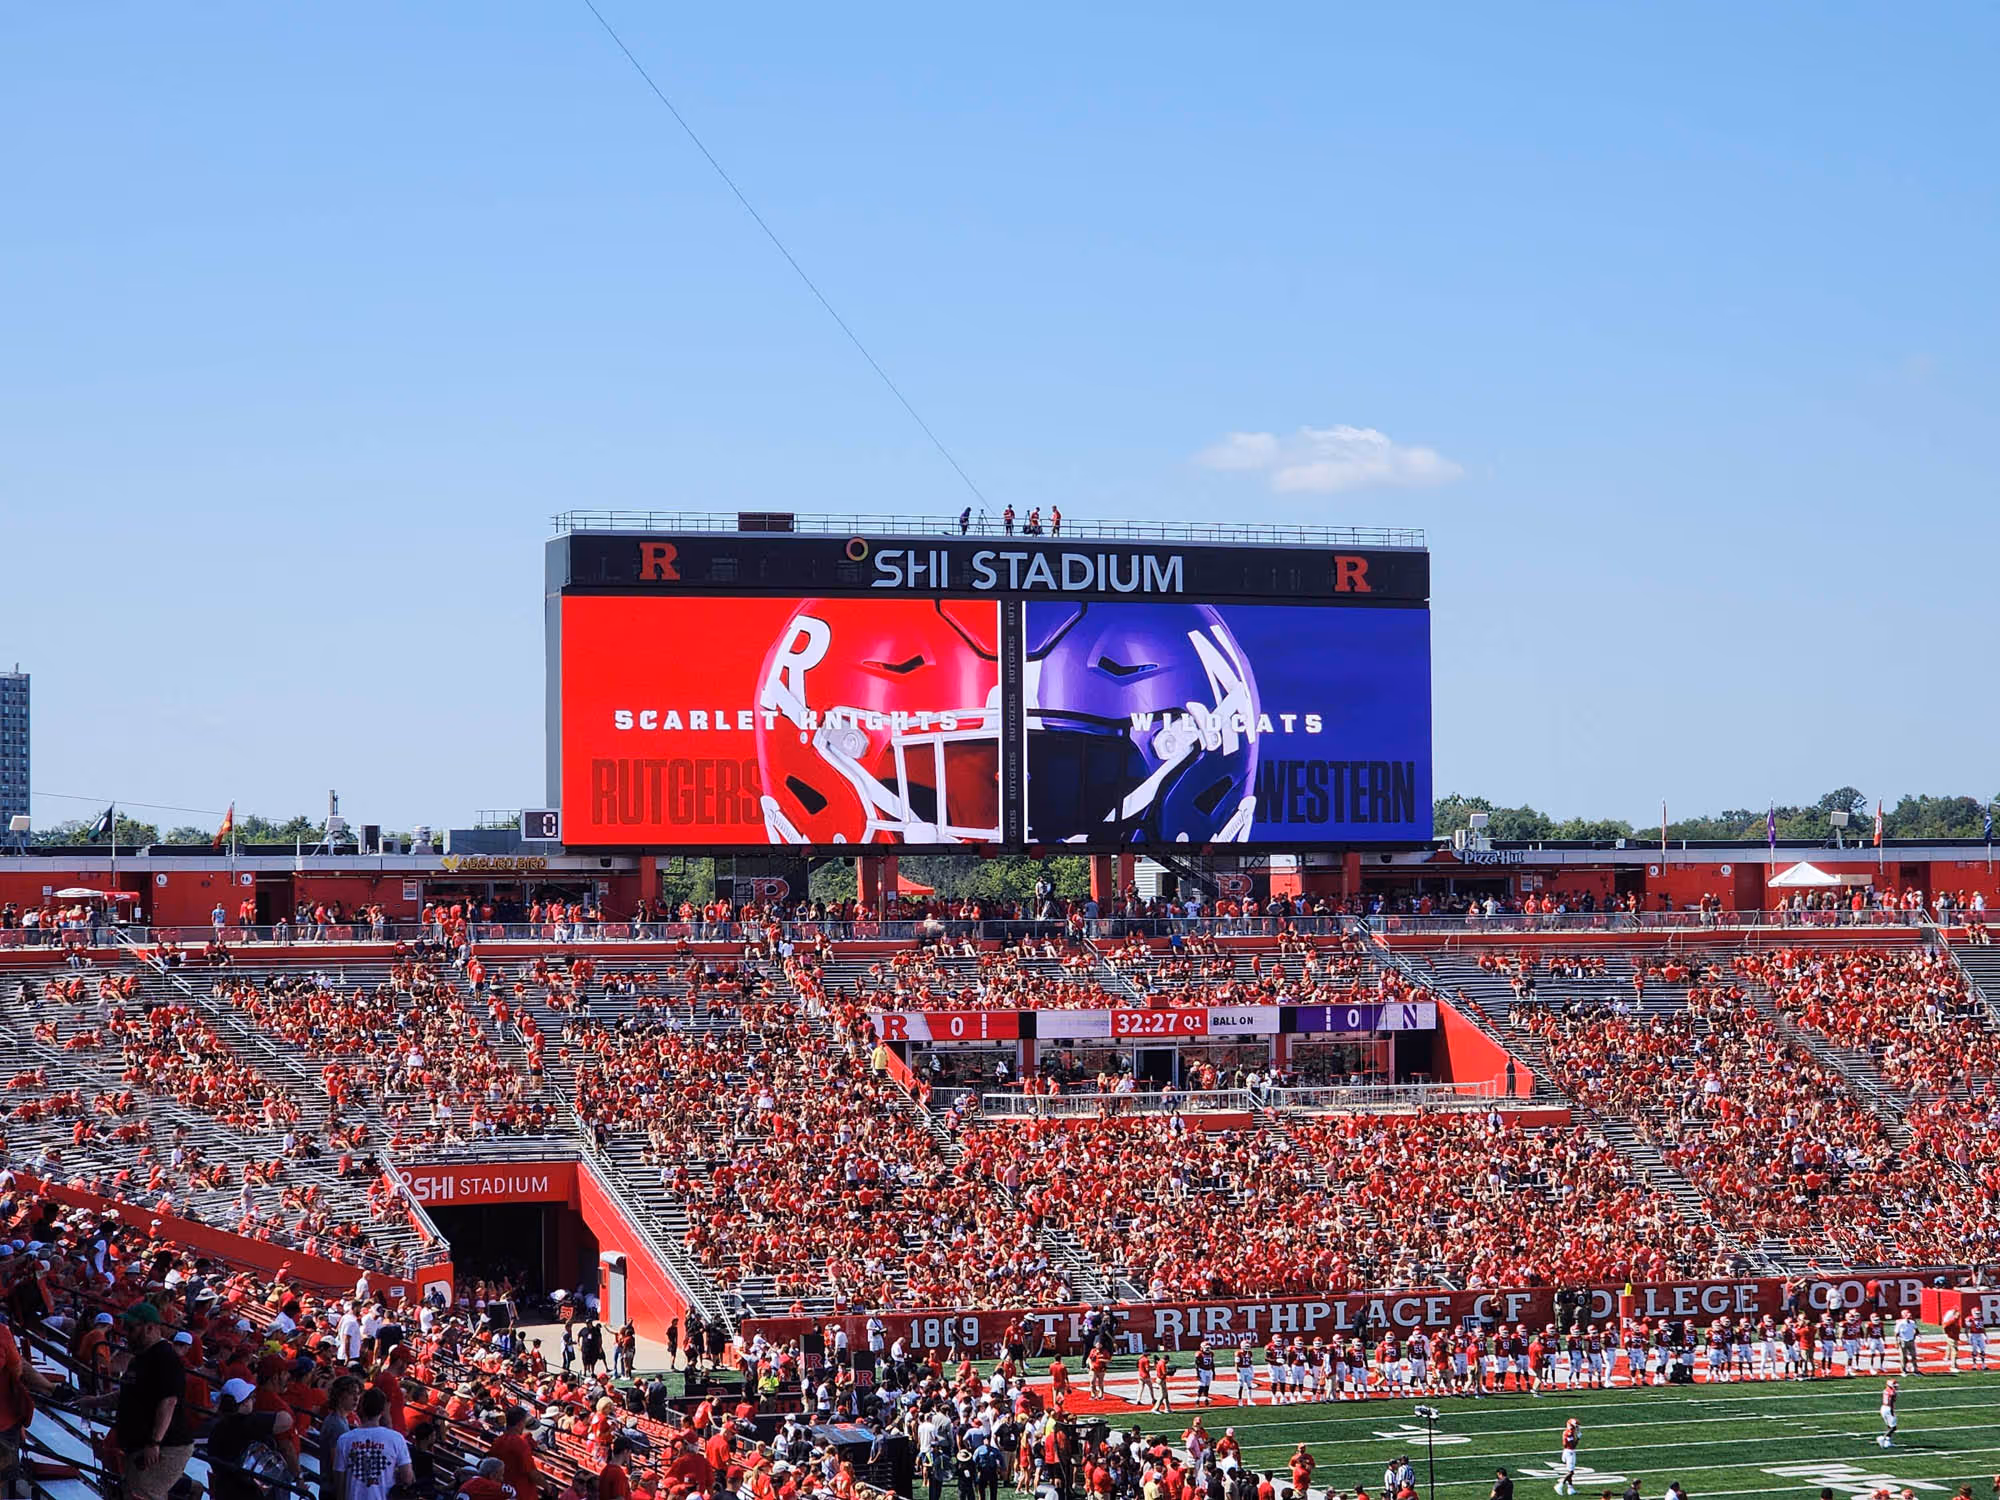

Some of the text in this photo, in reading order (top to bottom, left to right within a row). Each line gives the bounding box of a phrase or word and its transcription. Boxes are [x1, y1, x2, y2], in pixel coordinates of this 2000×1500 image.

[639, 542, 681, 581] R
[871, 549, 1184, 593] SHI STADIUM
[1334, 555, 1372, 593] R
[614, 709, 959, 731] SCARLET KNIGHTS
[1130, 712, 1323, 733] WILDCATS
[591, 758, 765, 825] RUTGERS
[1254, 759, 1416, 824] WESTERN
[517, 856, 548, 870] BIRD
[1464, 850, 1526, 865] Pizza Hut
[882, 1015, 910, 1040] R
[951, 1016, 964, 1037] 0
[1116, 1013, 1202, 1034] 32:27 Q1
[1212, 1016, 1254, 1026] BALL ON
[1347, 1008, 1360, 1028] 0
[1402, 1004, 1417, 1029] N
[414, 1175, 548, 1200] SHI STADIUM
[1153, 1296, 1453, 1339] BIRTHPLACE
[806, 1353, 824, 1369] R
[856, 1370, 874, 1387] R
